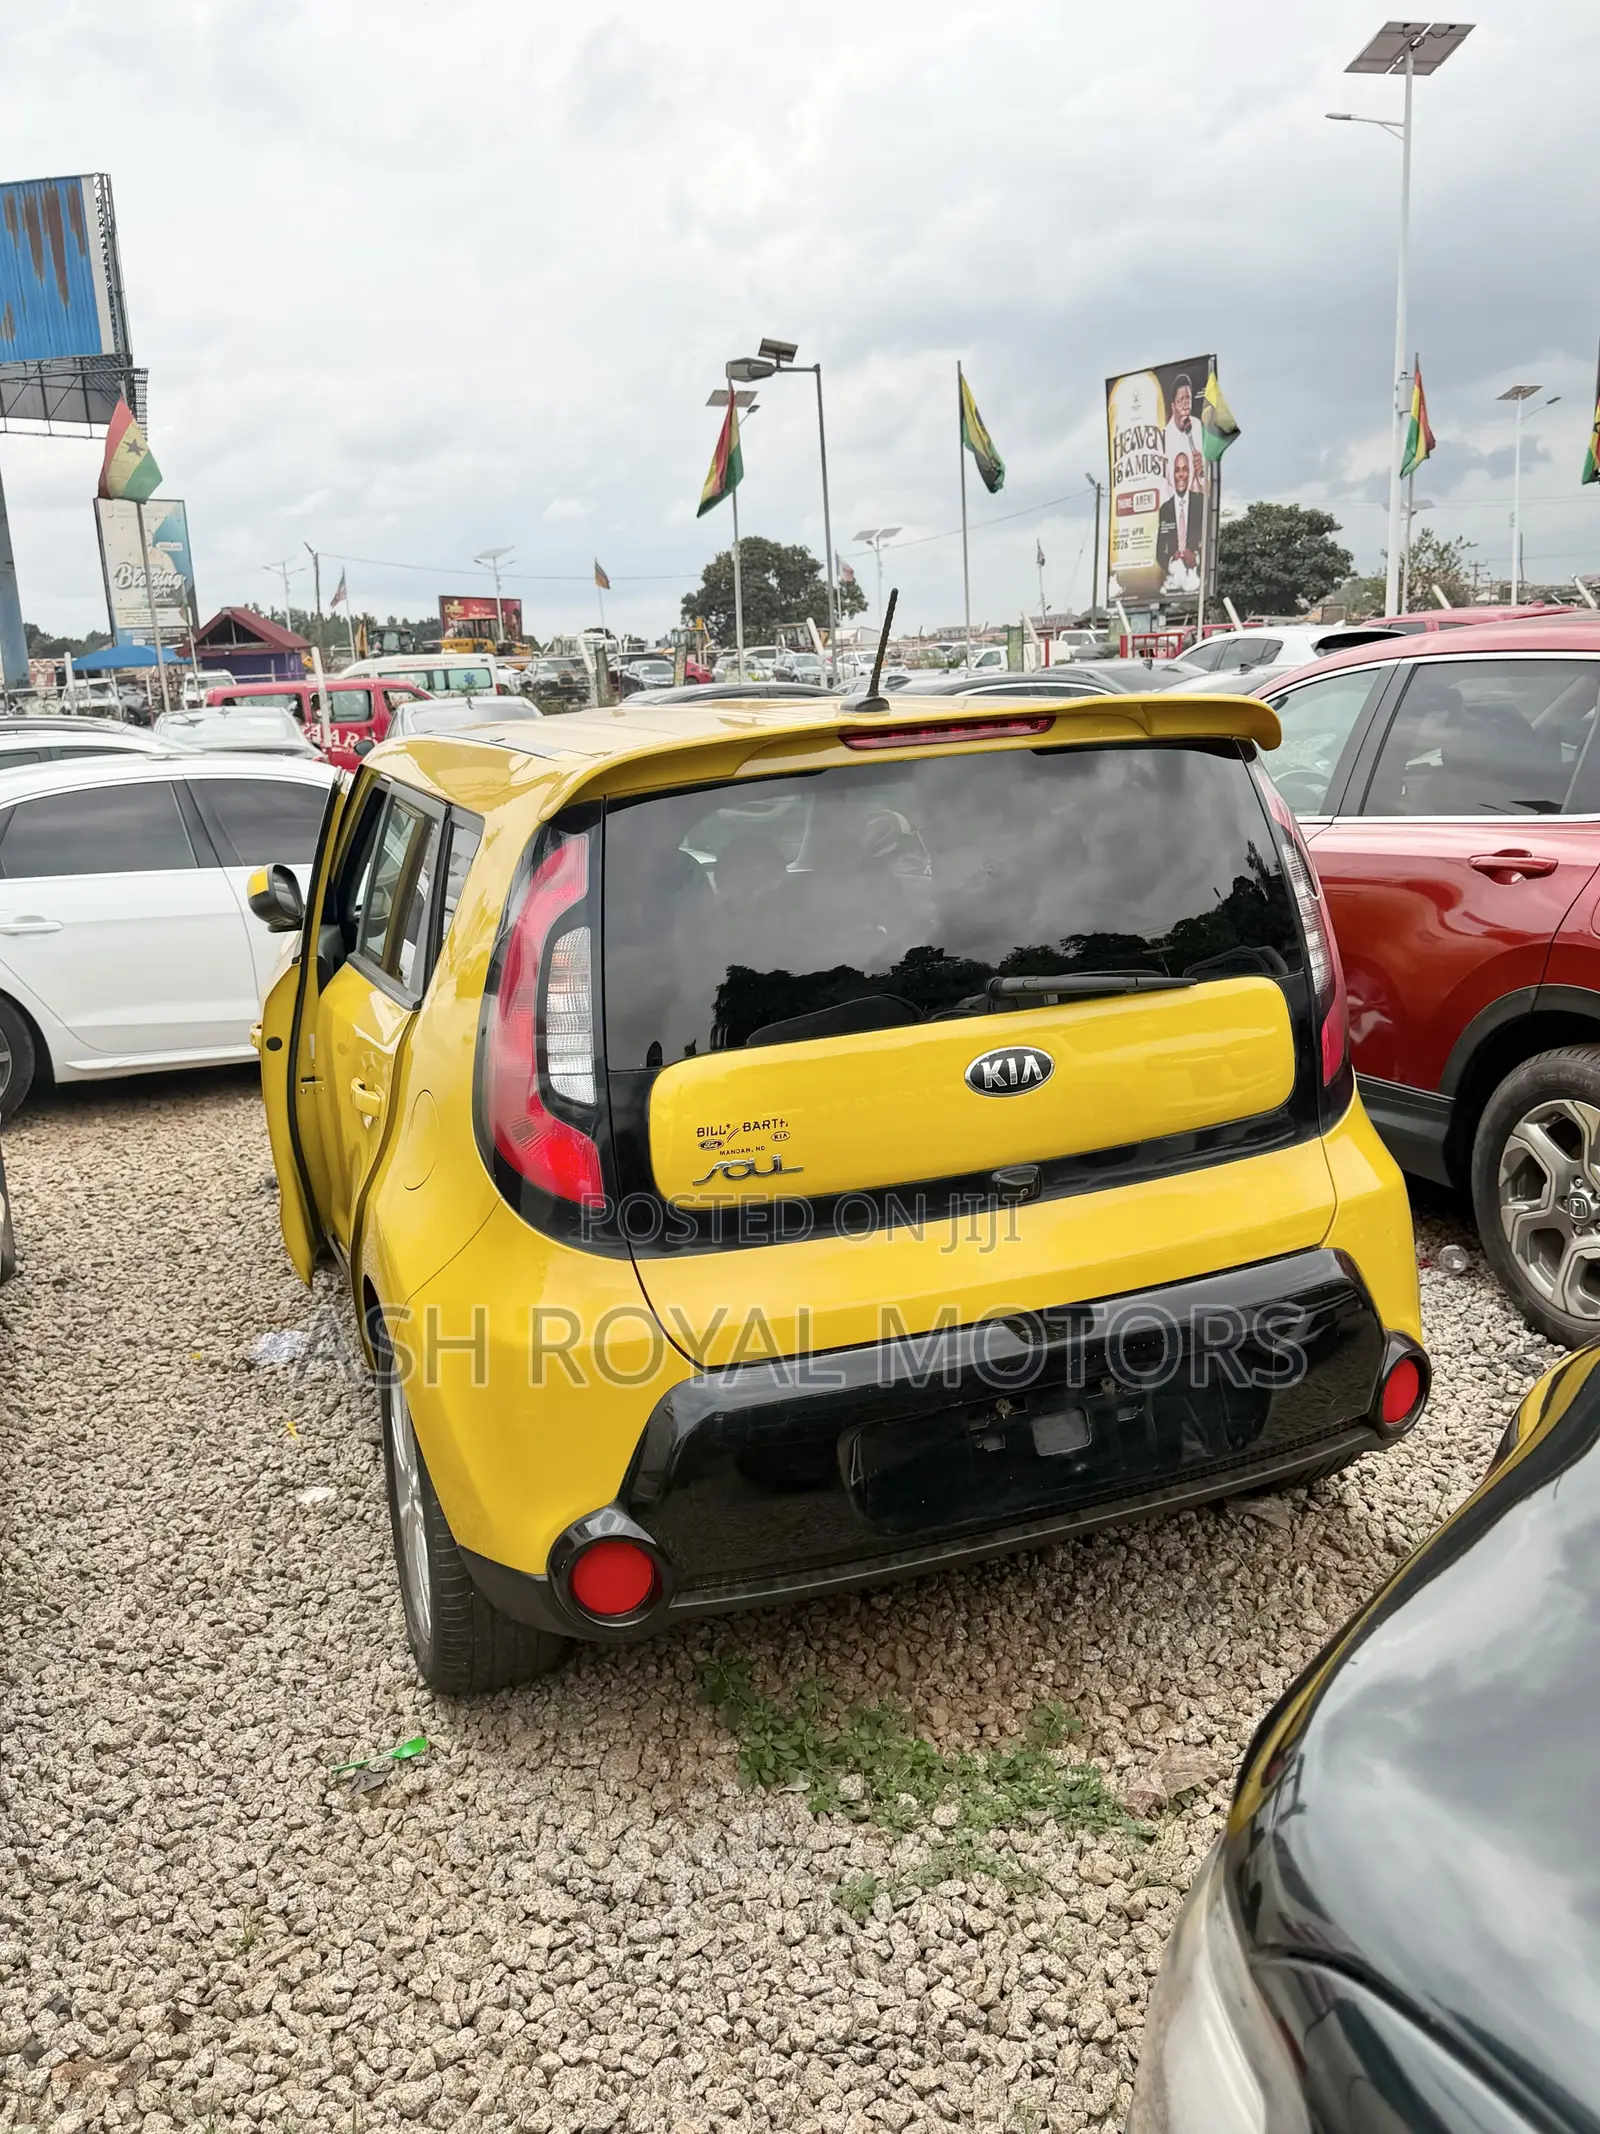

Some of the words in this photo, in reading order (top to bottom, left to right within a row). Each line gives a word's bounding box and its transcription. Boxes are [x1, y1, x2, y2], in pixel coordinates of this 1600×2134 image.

[1113, 425, 1166, 465] HEAVEN
[1113, 461, 1123, 488] IS
[1125, 457, 1134, 478] A
[1136, 454, 1169, 479] MUST
[114, 561, 184, 590] Blesing
[981, 1055, 1043, 1088] KIA
[696, 1124, 726, 1138] BILL
[773, 1132, 788, 1140] KIA
